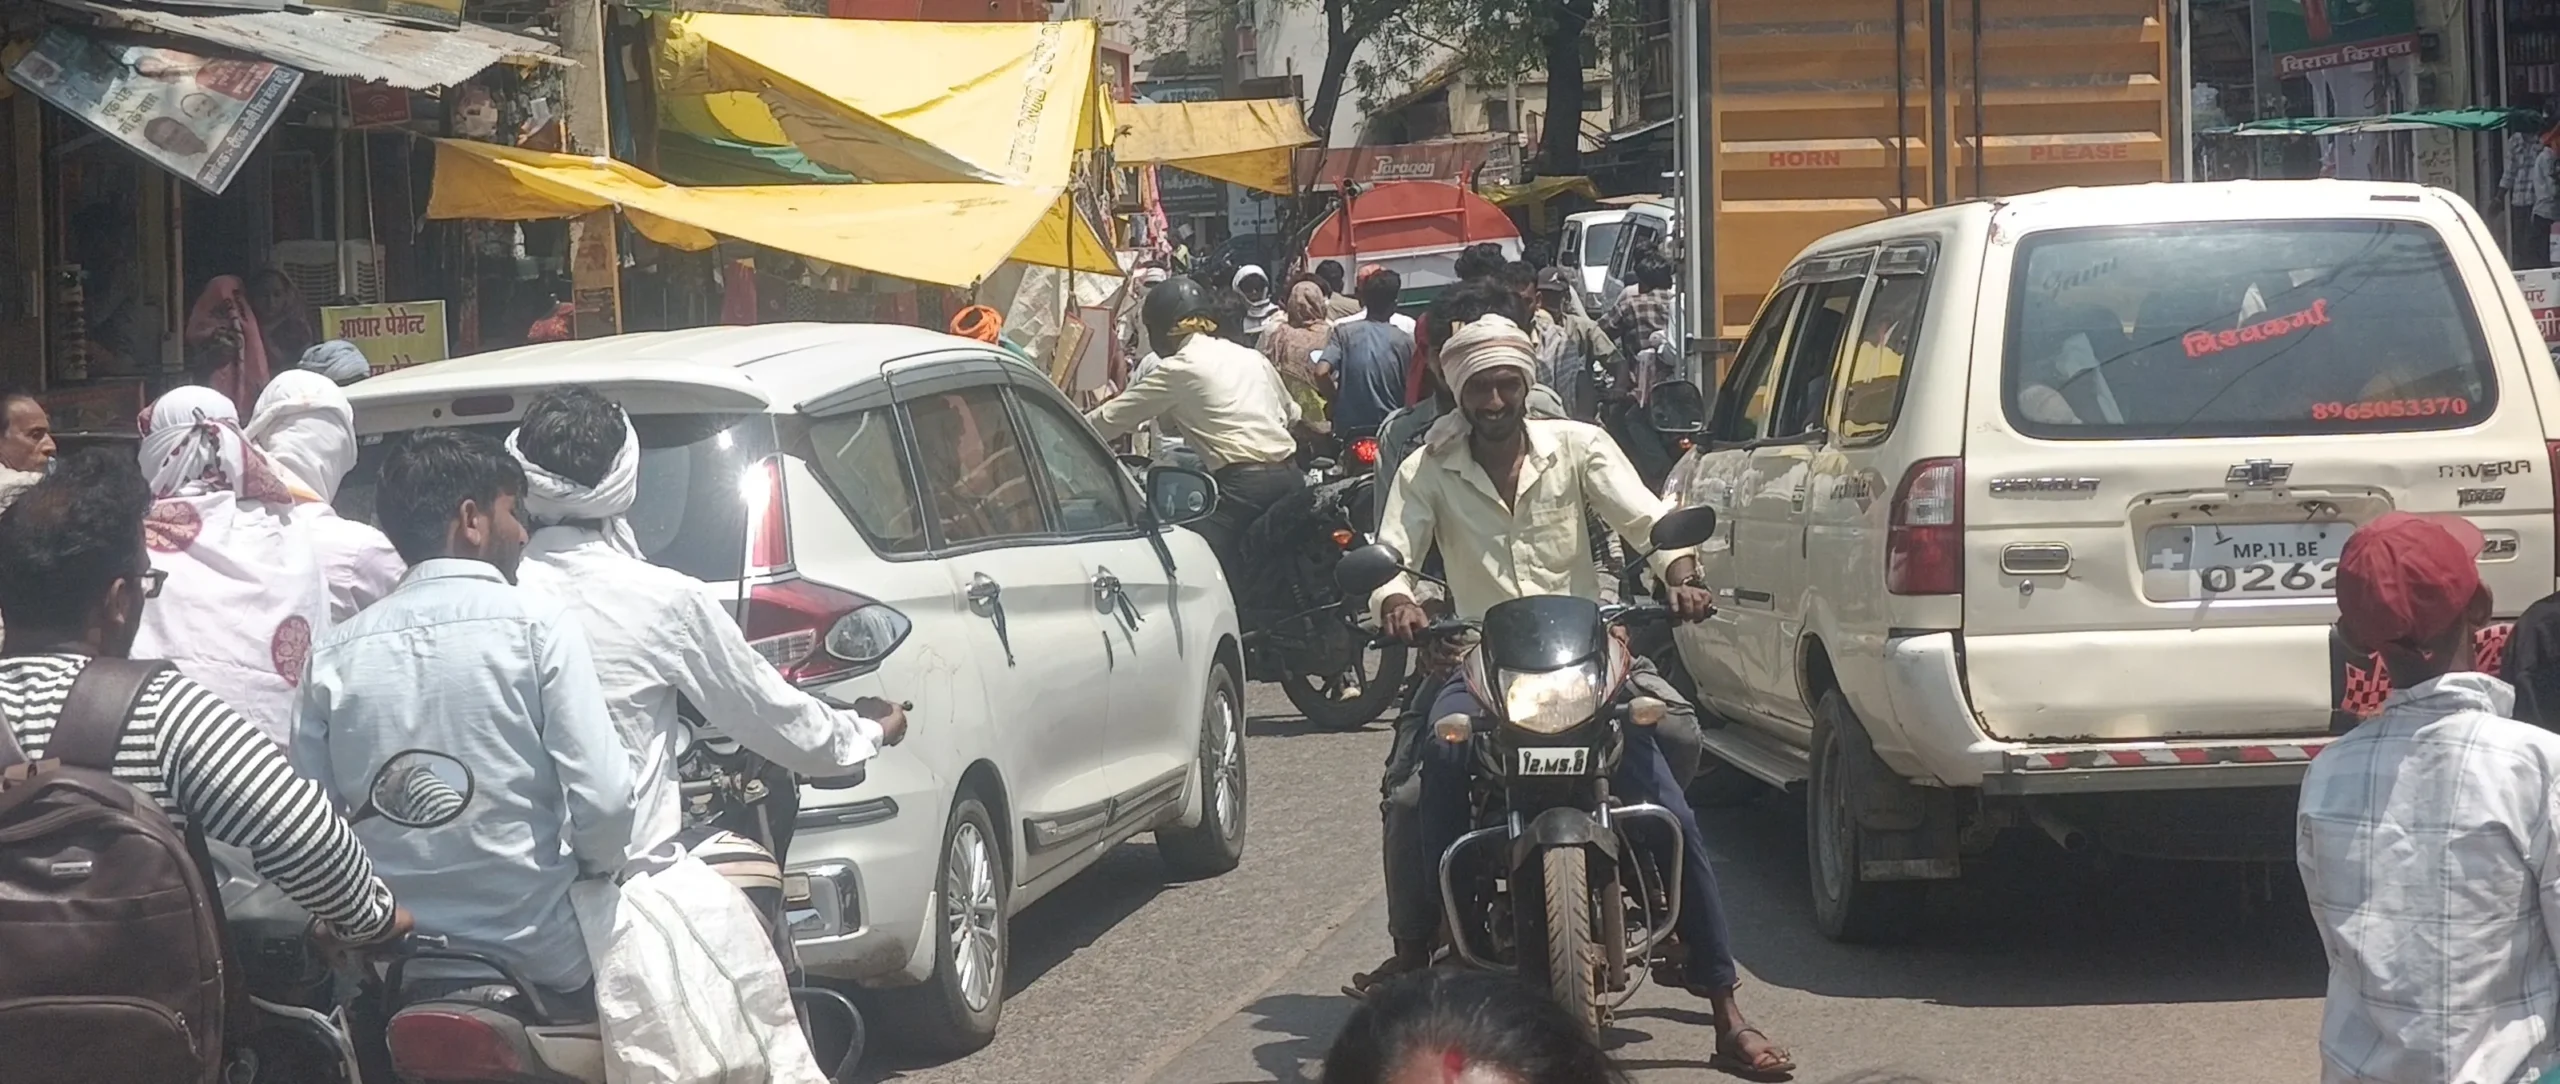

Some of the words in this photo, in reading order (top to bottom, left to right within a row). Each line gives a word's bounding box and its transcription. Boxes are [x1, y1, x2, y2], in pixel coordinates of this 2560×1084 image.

[2281, 52, 2338, 73] विराज
[2342, 41, 2412, 63] किराना
[1372, 155, 1436, 178] Paragon
[1769, 151, 1840, 167] HORN
[2029, 144, 2128, 160] PLEASE
[339, 317, 381, 338] आधार
[2312, 397, 2468, 421] 8965053370
[2233, 541, 2319, 559] MP.11.BE
